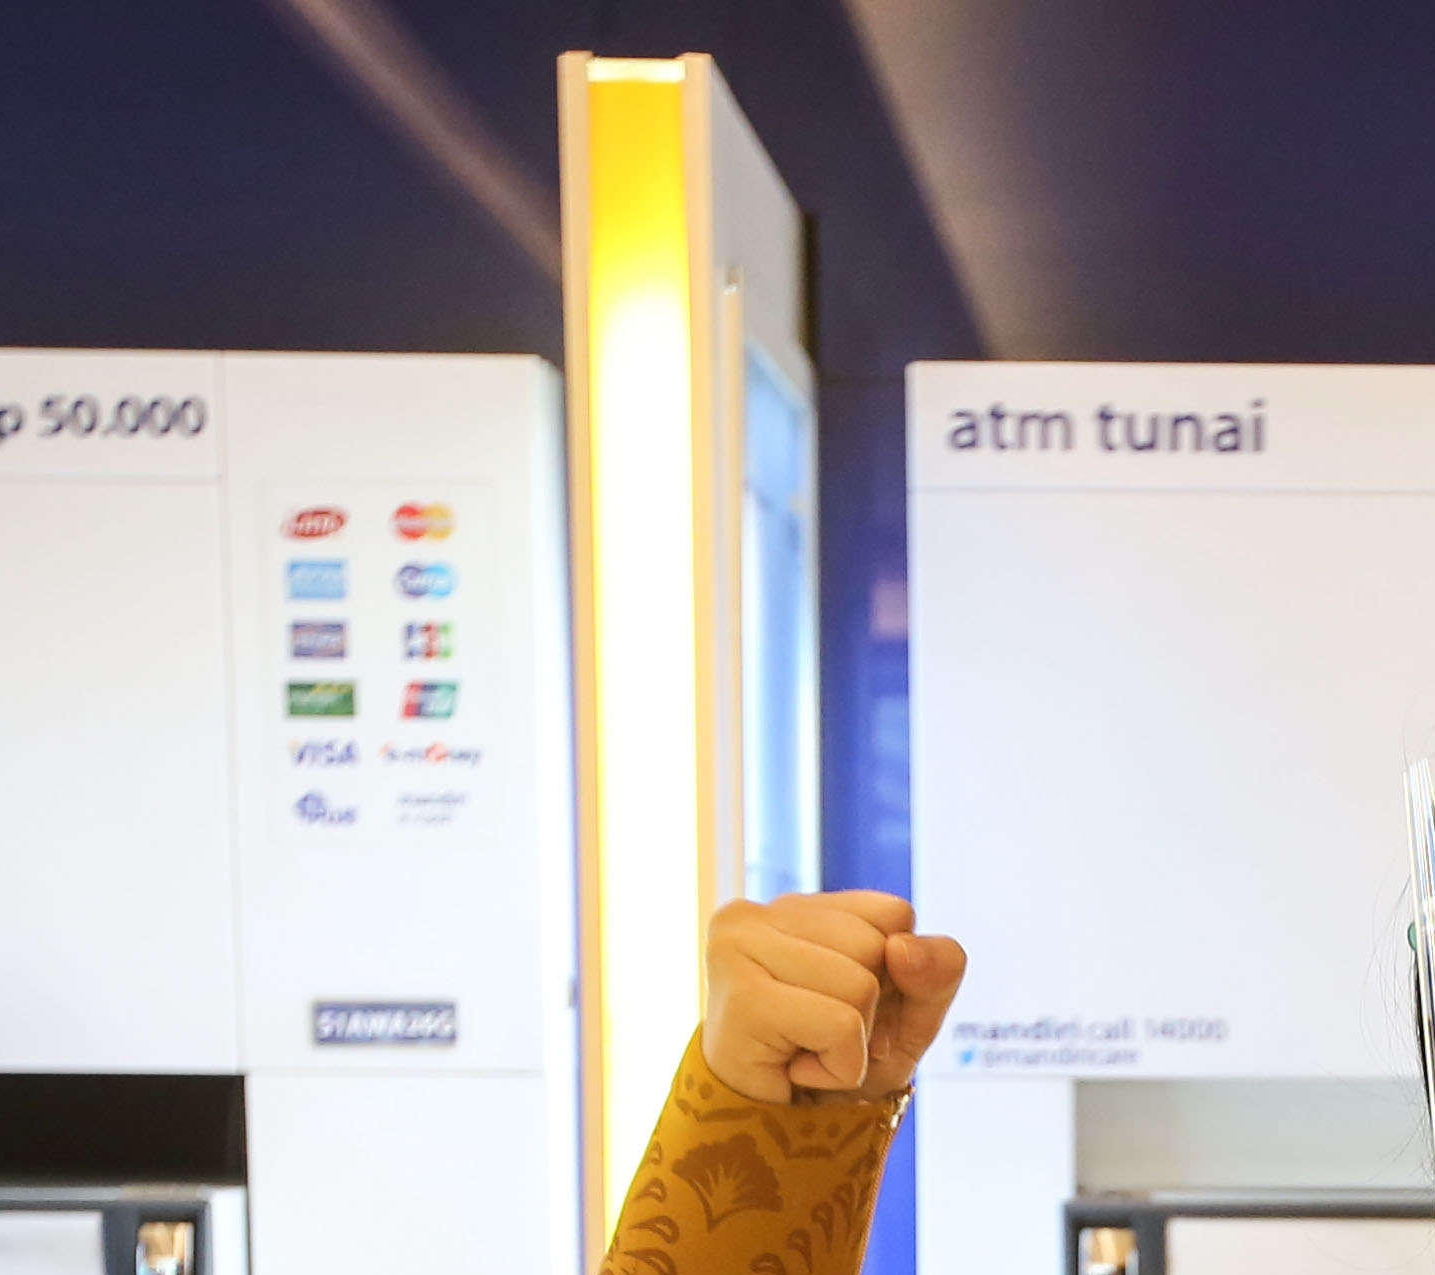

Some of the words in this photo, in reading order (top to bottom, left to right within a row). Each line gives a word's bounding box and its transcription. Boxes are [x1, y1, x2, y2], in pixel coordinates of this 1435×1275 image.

[39, 396, 207, 439] 50.000
[949, 401, 1073, 453] atm
[1095, 398, 1266, 454] tunai
